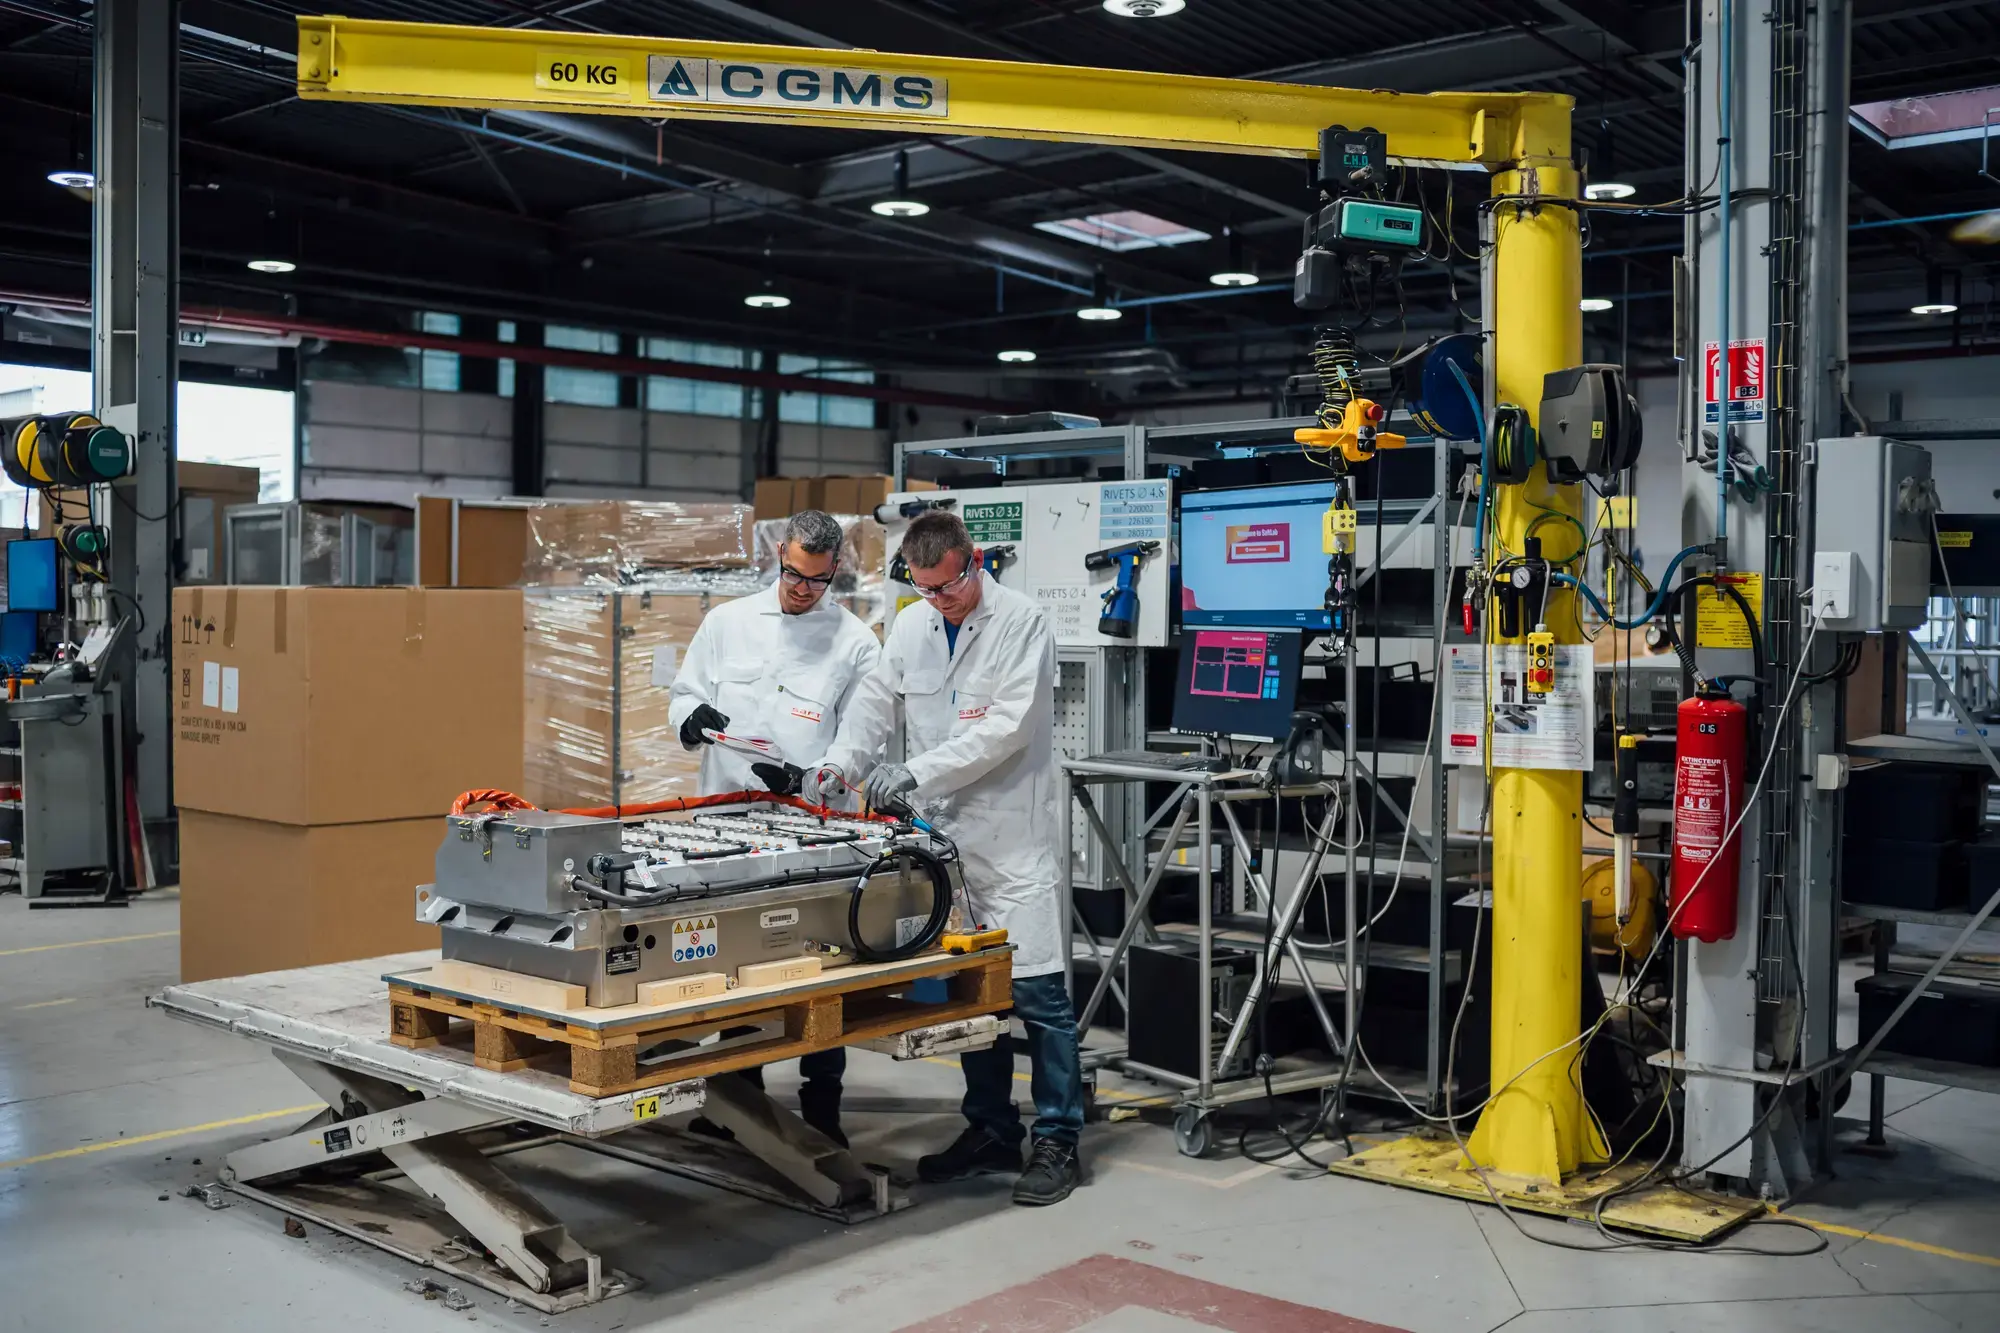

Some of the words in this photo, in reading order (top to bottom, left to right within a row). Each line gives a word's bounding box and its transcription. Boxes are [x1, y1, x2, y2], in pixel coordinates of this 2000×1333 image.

[549, 62, 579, 83] 60
[585, 63, 618, 86] KG
[720, 64, 934, 110] CGMS
[1706, 339, 1764, 350] EXNCTEUR
[1103, 488, 1136, 500] RIVETS
[965, 507, 995, 519] RIVETS
[1007, 505, 1020, 519] 3,2
[1037, 588, 1067, 599] RIVETS
[648, 1100, 658, 1115] 4
